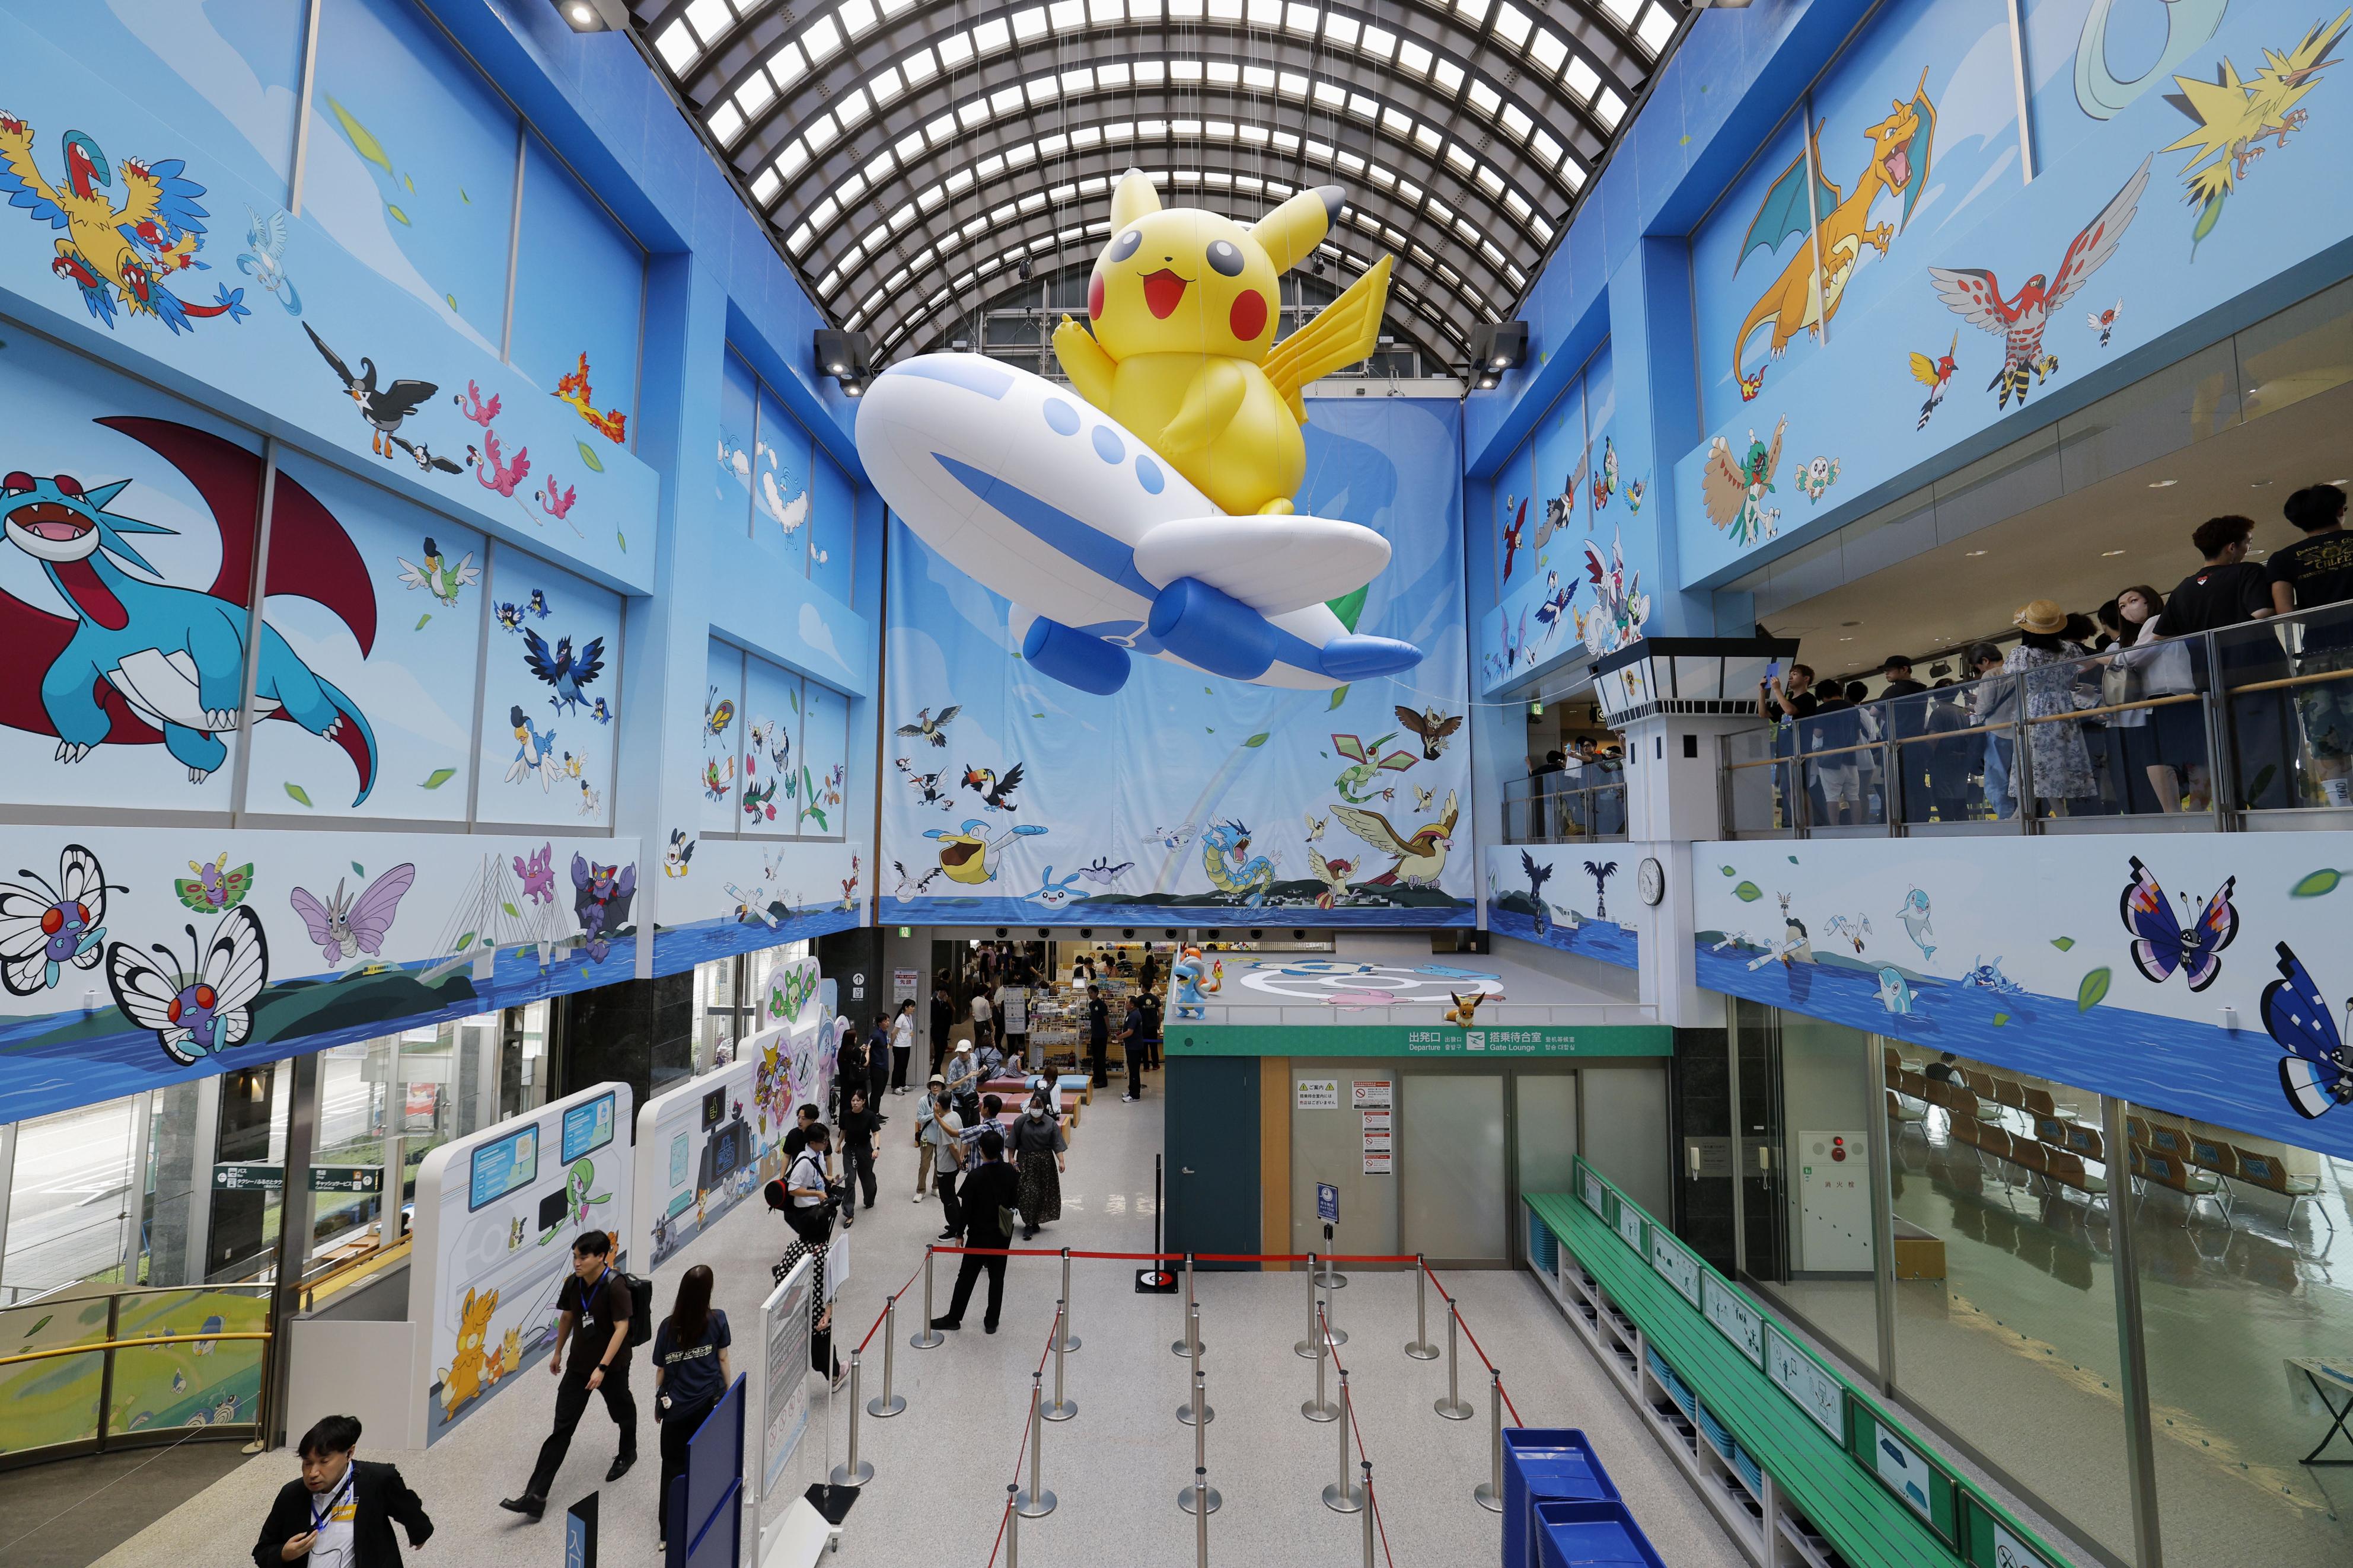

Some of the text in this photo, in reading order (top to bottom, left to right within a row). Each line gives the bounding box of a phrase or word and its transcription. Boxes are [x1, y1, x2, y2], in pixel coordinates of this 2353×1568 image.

[1408, 1032, 1441, 1043] 出発口
[1490, 1032, 1542, 1043] 搭乗待合室
